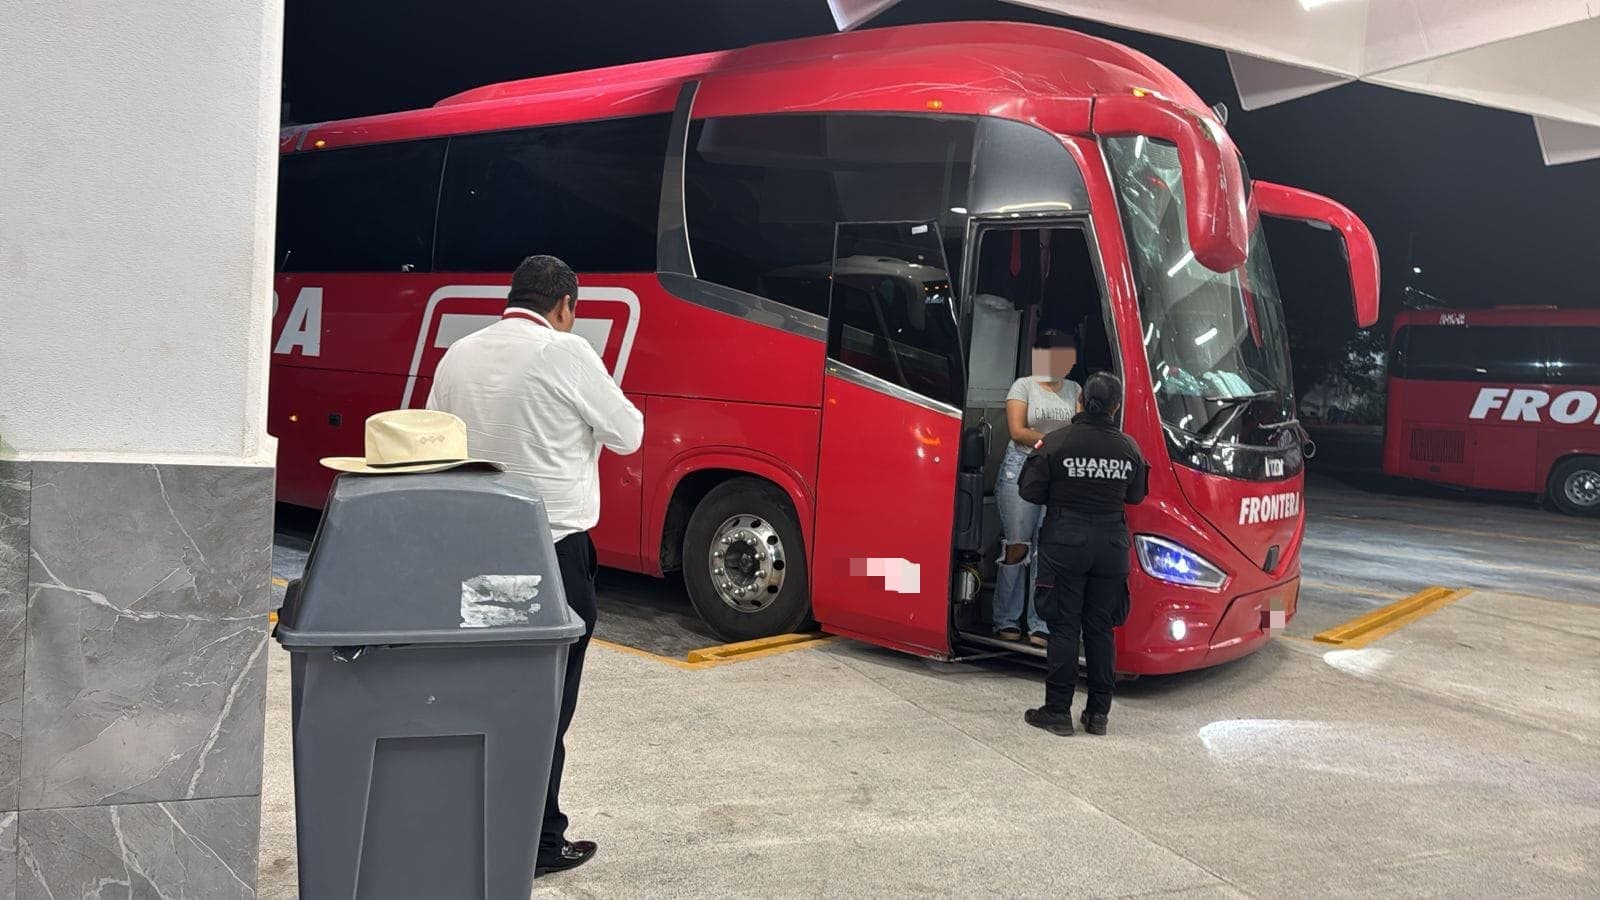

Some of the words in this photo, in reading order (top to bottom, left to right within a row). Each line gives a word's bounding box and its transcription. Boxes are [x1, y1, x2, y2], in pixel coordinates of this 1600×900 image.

[272, 287, 323, 357] A
[1469, 387, 1600, 425] FRO
[1062, 457, 1133, 472] GUARDIA
[1067, 467, 1128, 480] ESTATAL
[1238, 491, 1300, 525] FRONTERA
